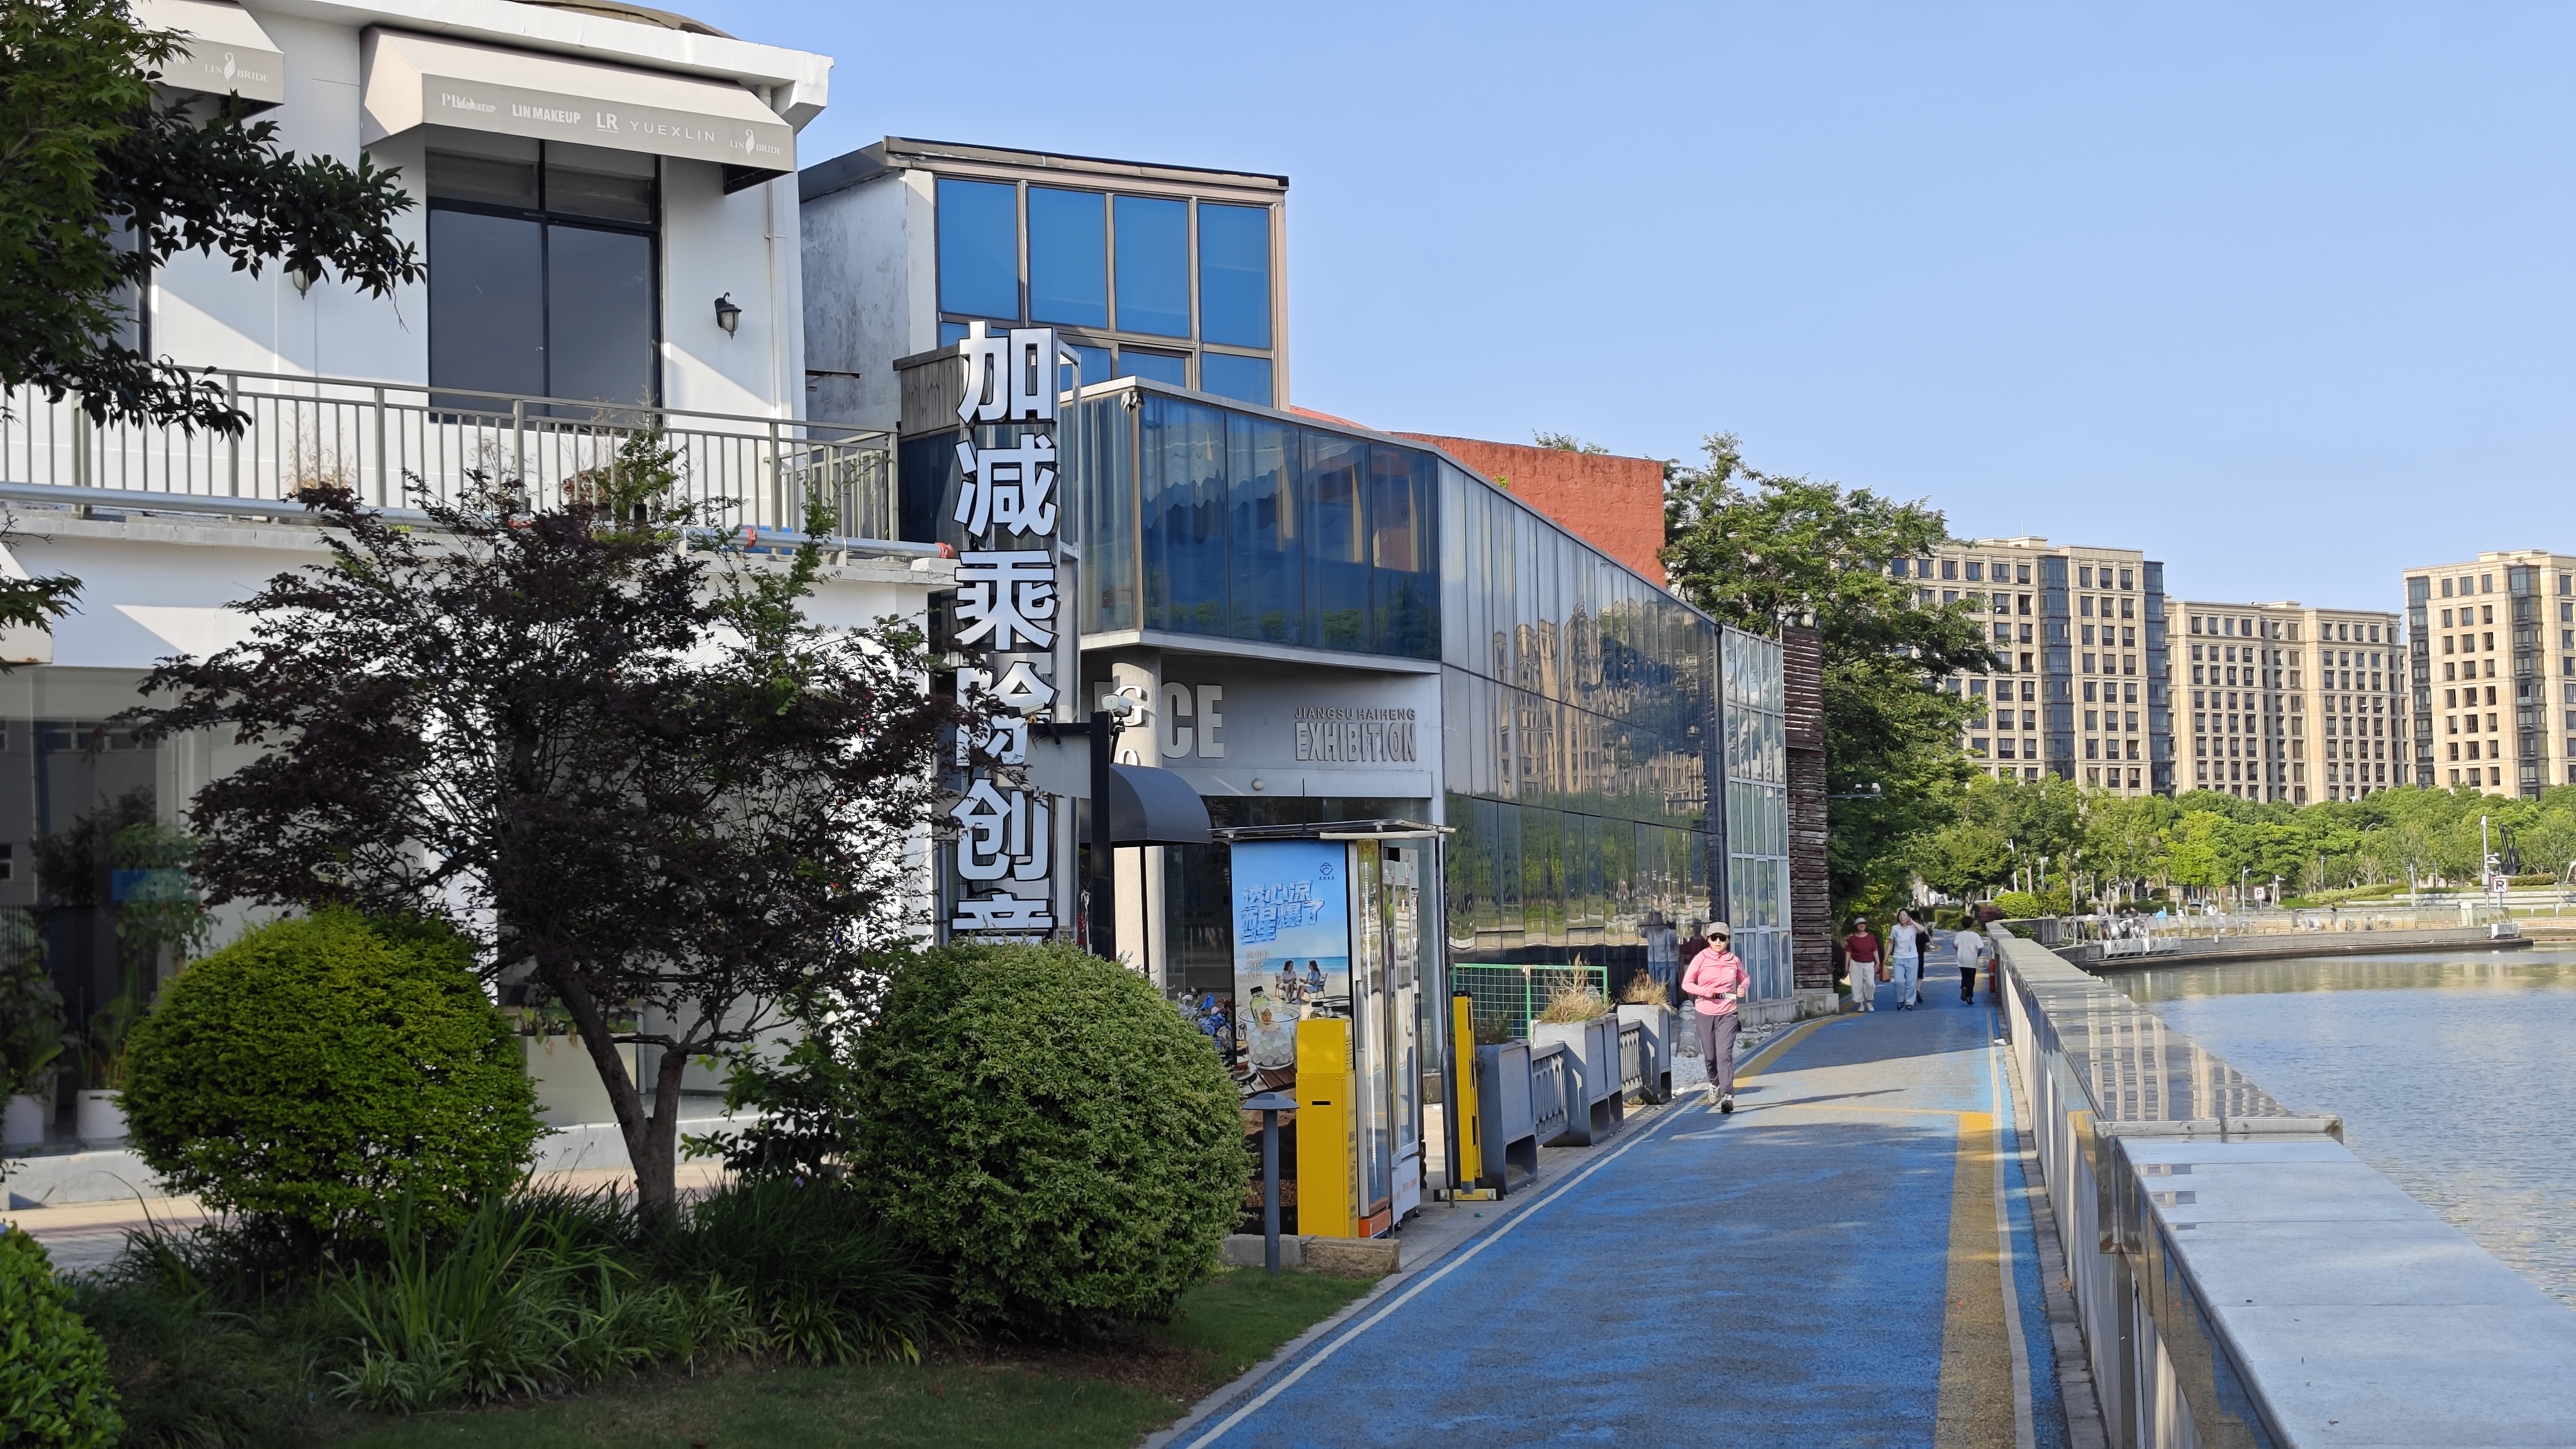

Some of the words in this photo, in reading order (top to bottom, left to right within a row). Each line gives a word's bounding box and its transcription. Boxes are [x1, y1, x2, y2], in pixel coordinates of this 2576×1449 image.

[204, 64, 222, 74] LIN
[237, 69, 269, 82] BRIDE
[512, 104, 531, 118] LIN
[533, 106, 580, 124] MAKEUP
[597, 112, 619, 130] LR
[630, 120, 715, 142] YUEXLIN
[730, 140, 744, 149] LIN
[756, 143, 782, 155] BRIDE
[1295, 707, 1353, 719] JIANGSU
[1357, 708, 1416, 720] HAIHENG
[1295, 722, 1416, 762] EXHIBITION
[1241, 879, 1313, 907] 透心凉
[1240, 900, 1325, 945] 醒爆了
